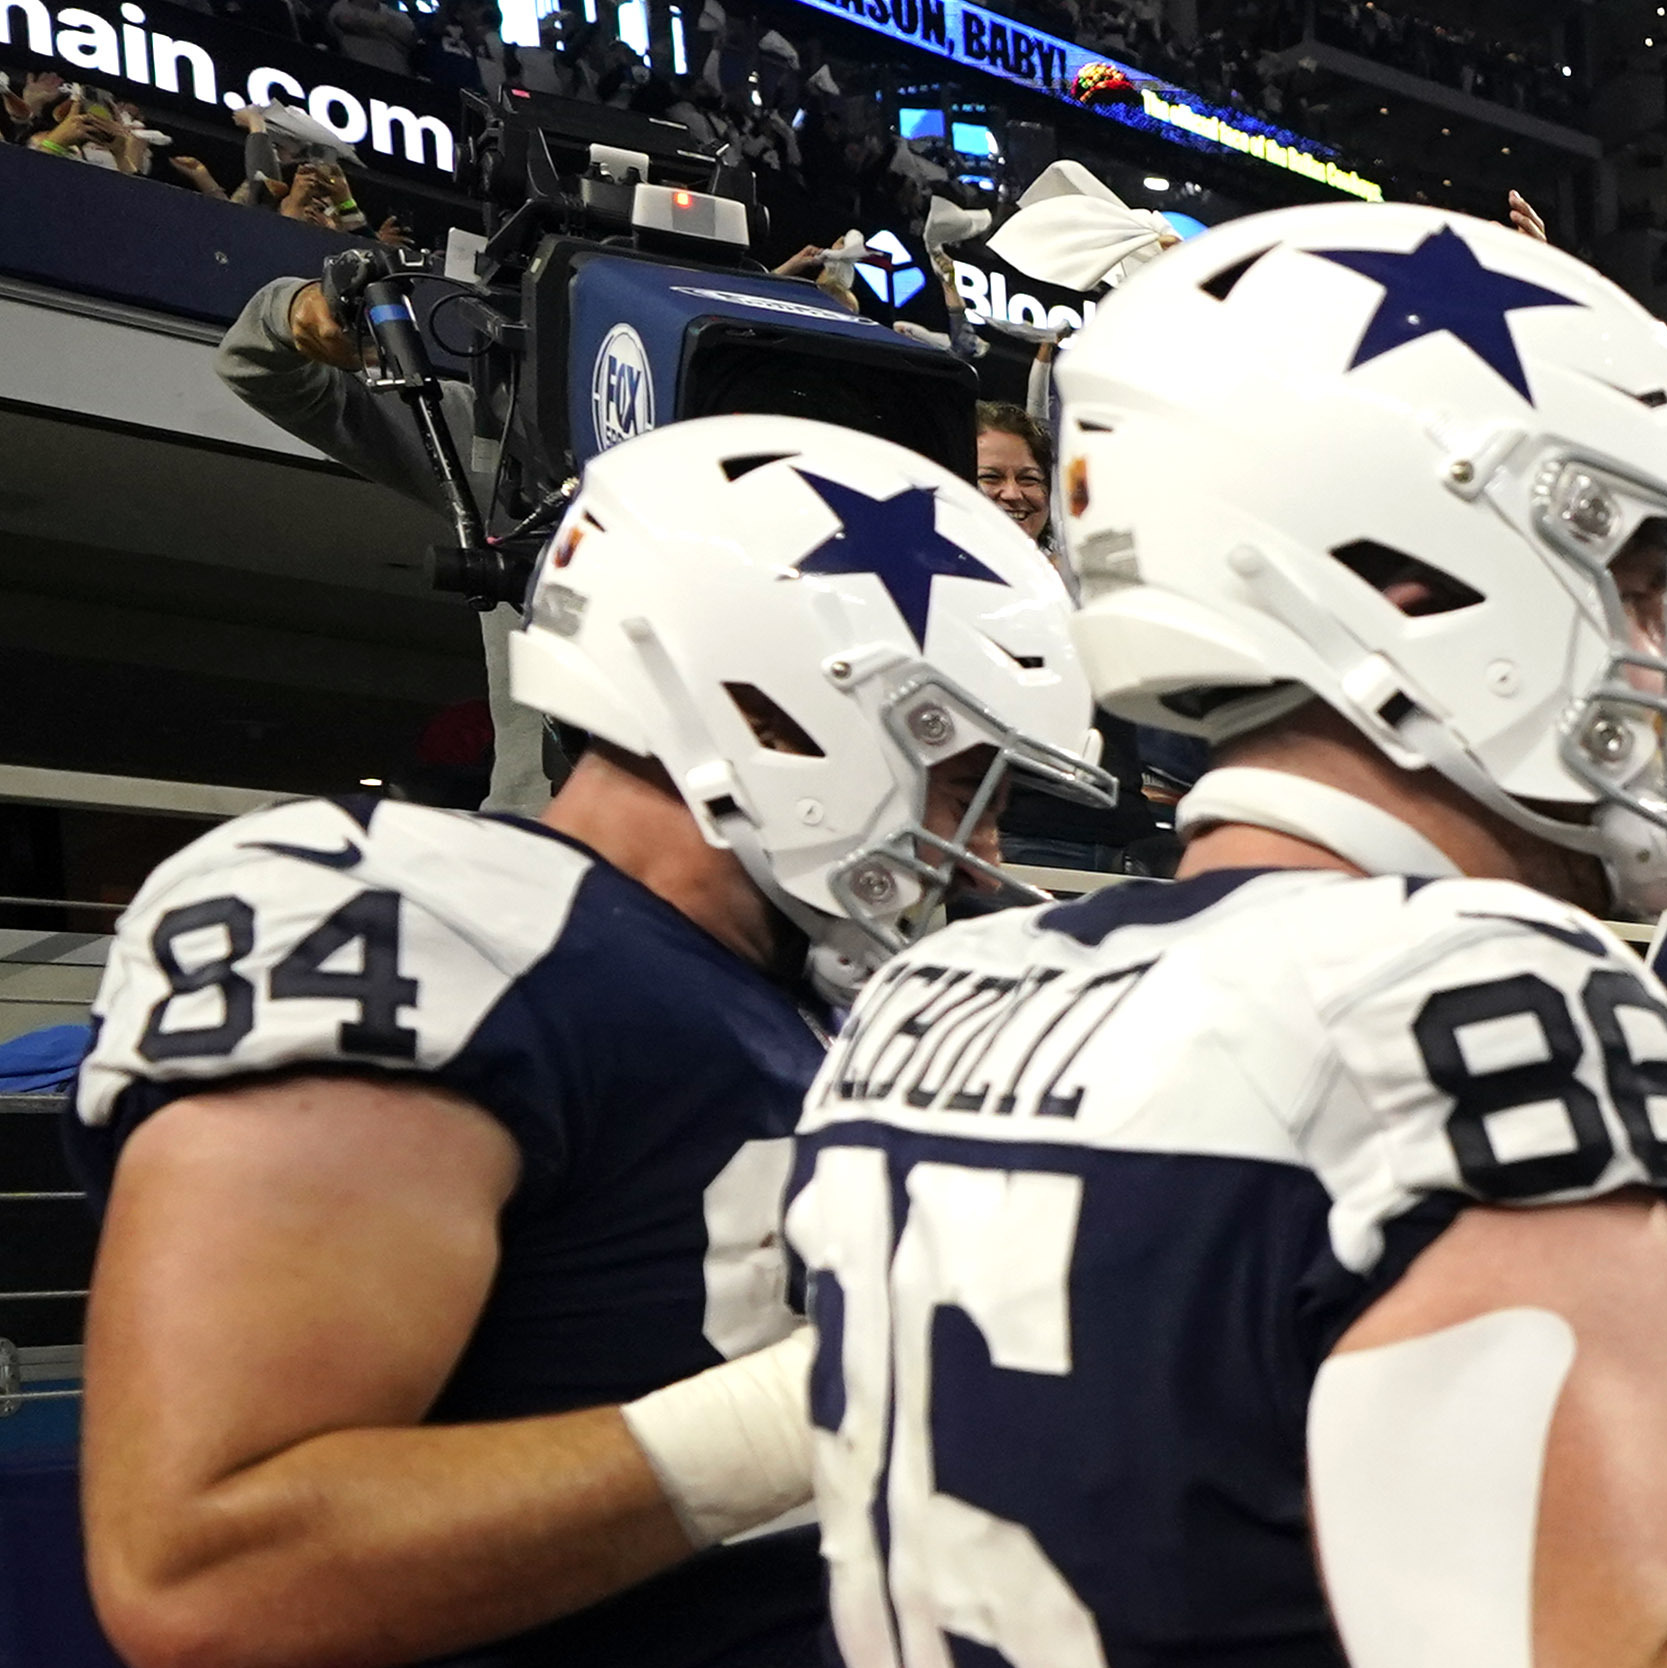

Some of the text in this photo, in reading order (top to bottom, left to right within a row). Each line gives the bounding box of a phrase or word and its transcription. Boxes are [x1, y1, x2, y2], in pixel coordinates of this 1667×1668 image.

[961, 9, 1067, 87] BABY!
[953, 260, 1096, 350] Bloc
[606, 354, 641, 435] FOX
[136, 888, 419, 1063] 84
